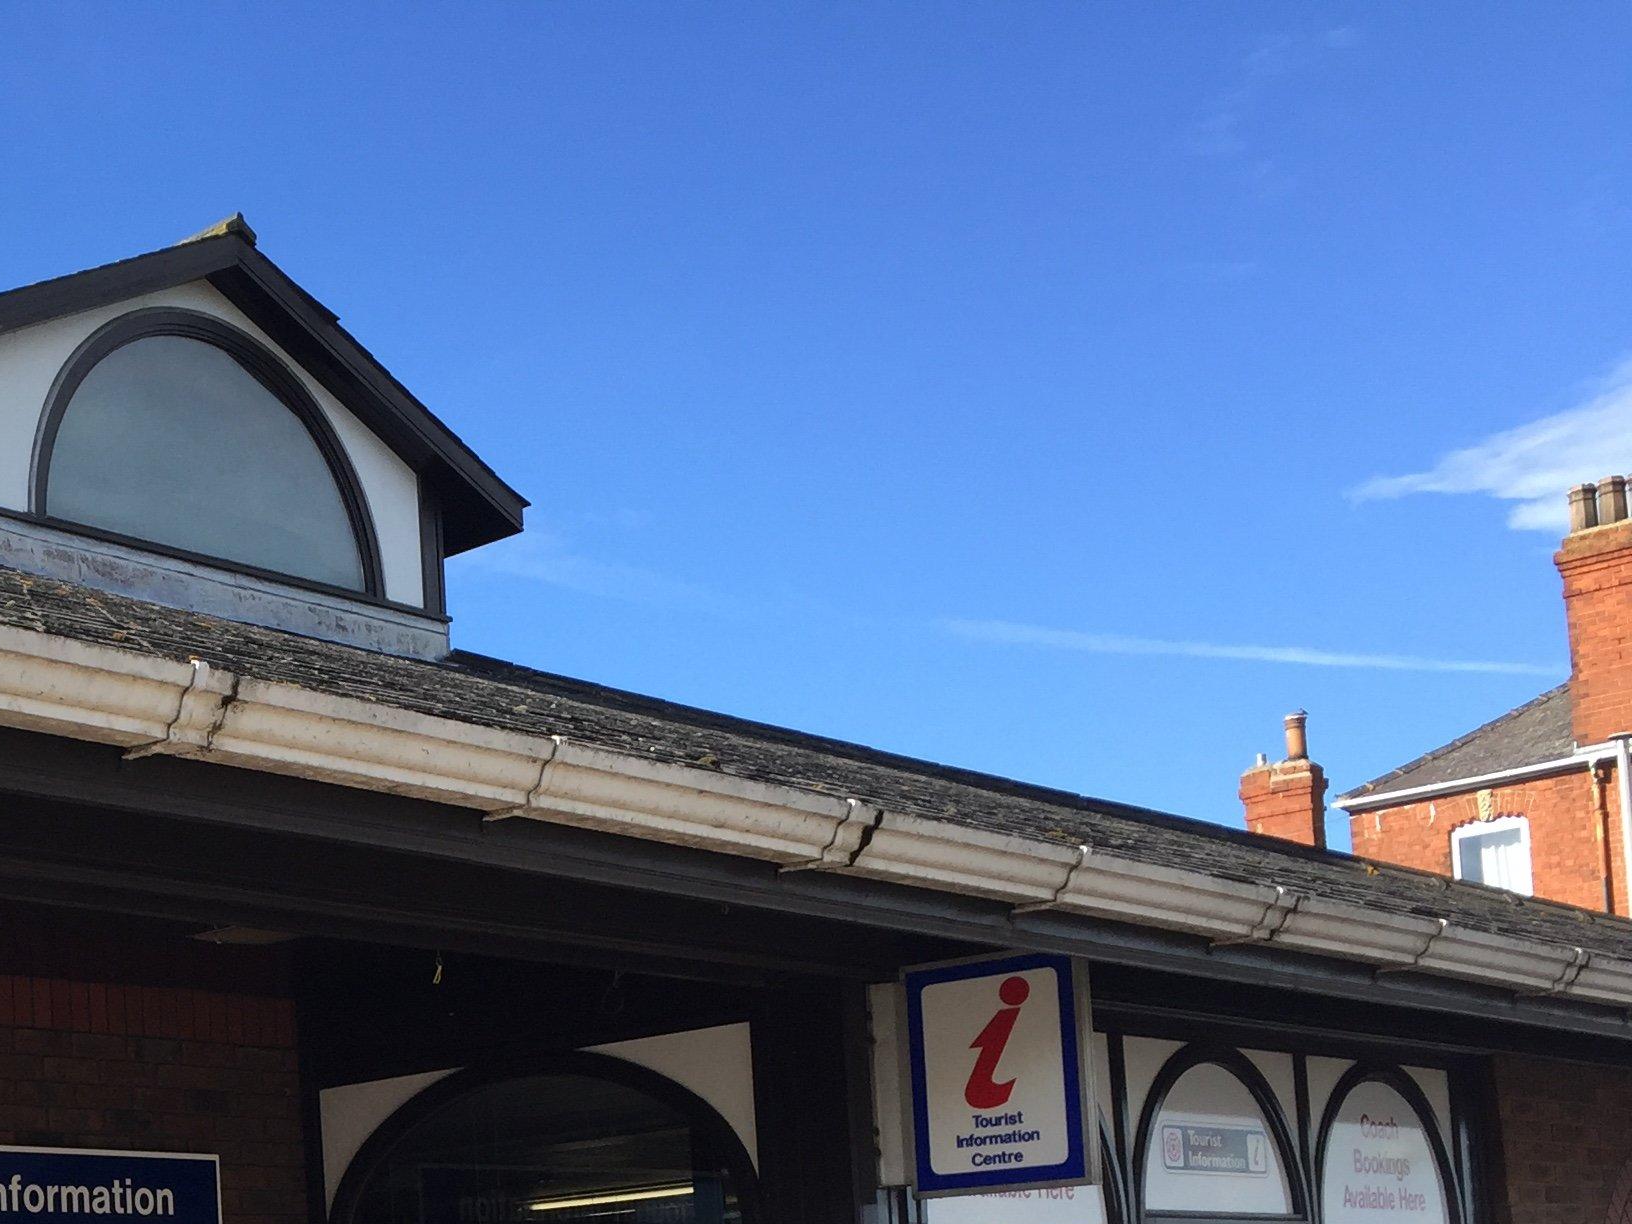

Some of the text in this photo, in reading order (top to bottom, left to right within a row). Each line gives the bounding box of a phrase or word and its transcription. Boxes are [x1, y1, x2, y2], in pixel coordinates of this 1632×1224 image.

[964, 976, 1030, 1110] i
[972, 1110, 1023, 1129] Tourist
[1360, 1113, 1399, 1140] Coach
[956, 1126, 1040, 1148] Information
[1188, 1130, 1222, 1148] Tourist
[972, 1147, 1024, 1167] Centre
[1188, 1151, 1245, 1169] Information
[1353, 1148, 1410, 1181] Bookings
[1343, 1184, 1426, 1211] Available Here
